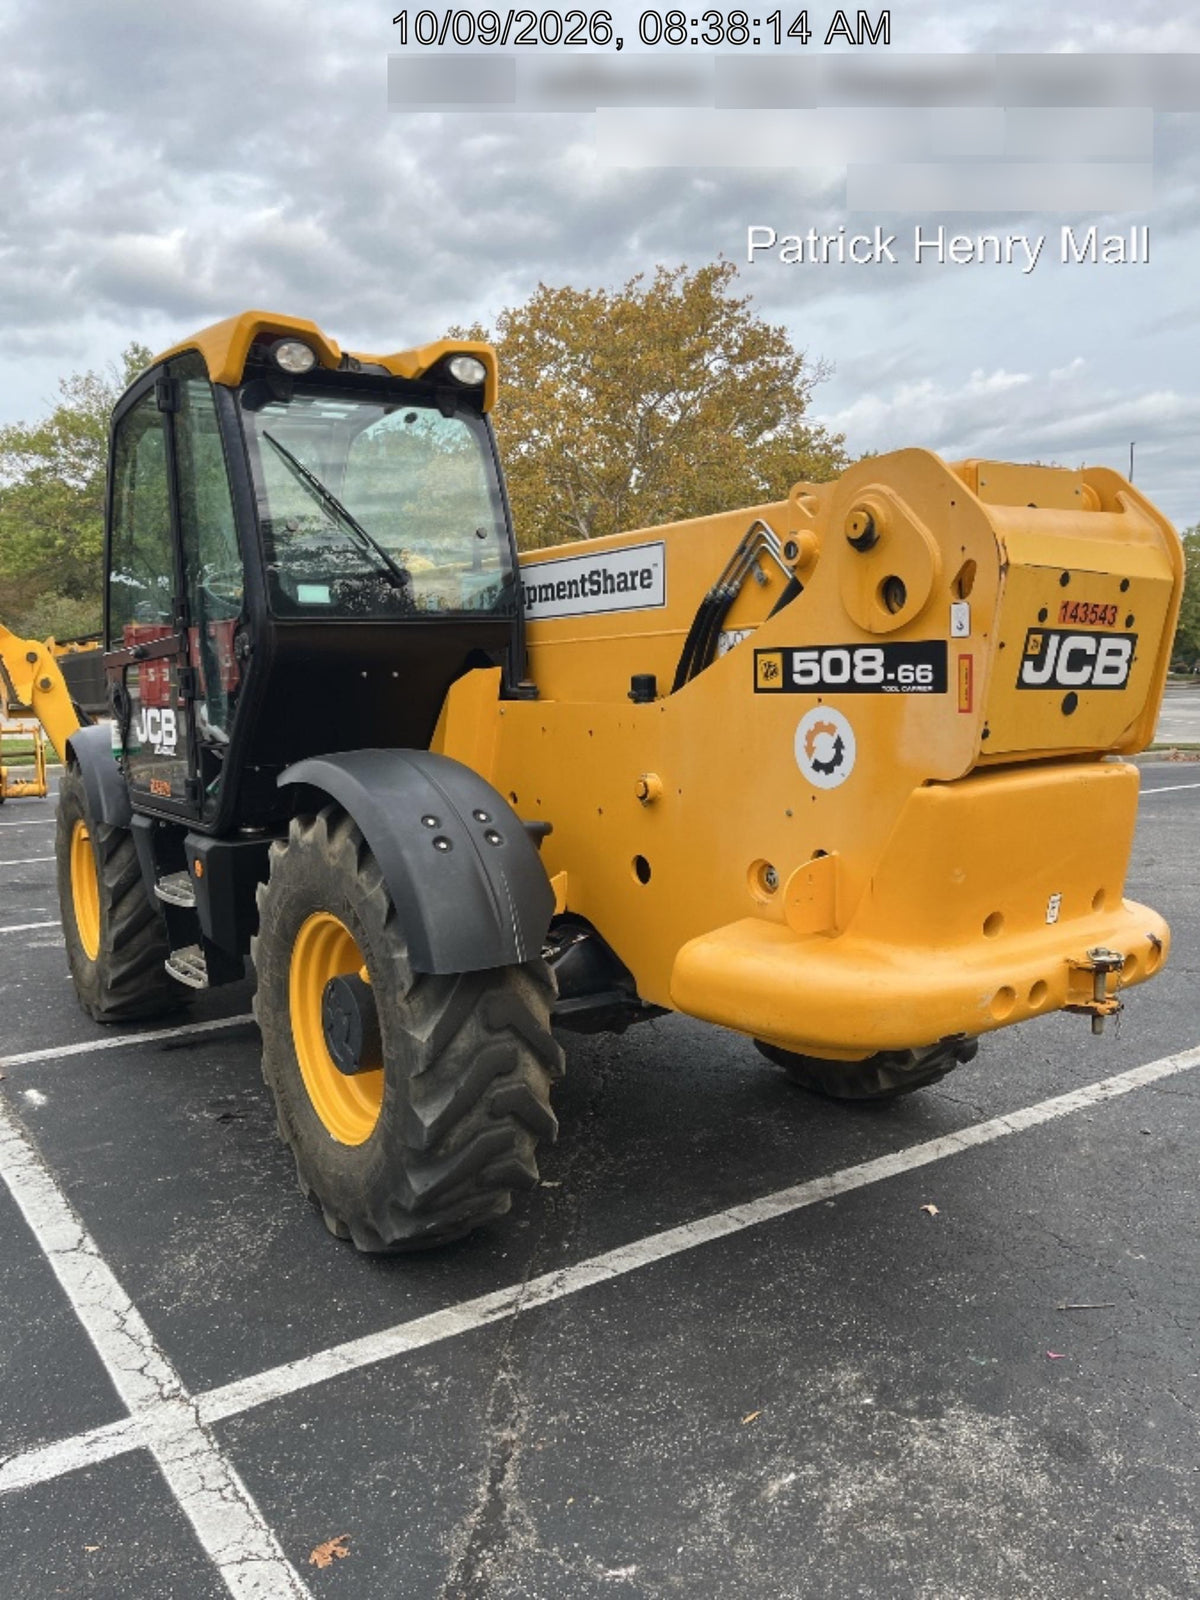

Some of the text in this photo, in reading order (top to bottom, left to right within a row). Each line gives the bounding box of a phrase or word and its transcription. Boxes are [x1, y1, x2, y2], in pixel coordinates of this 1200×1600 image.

[1061, 602, 1118, 626] 143543
[1021, 634, 1133, 686] JCB
[135, 707, 177, 746] JCB
